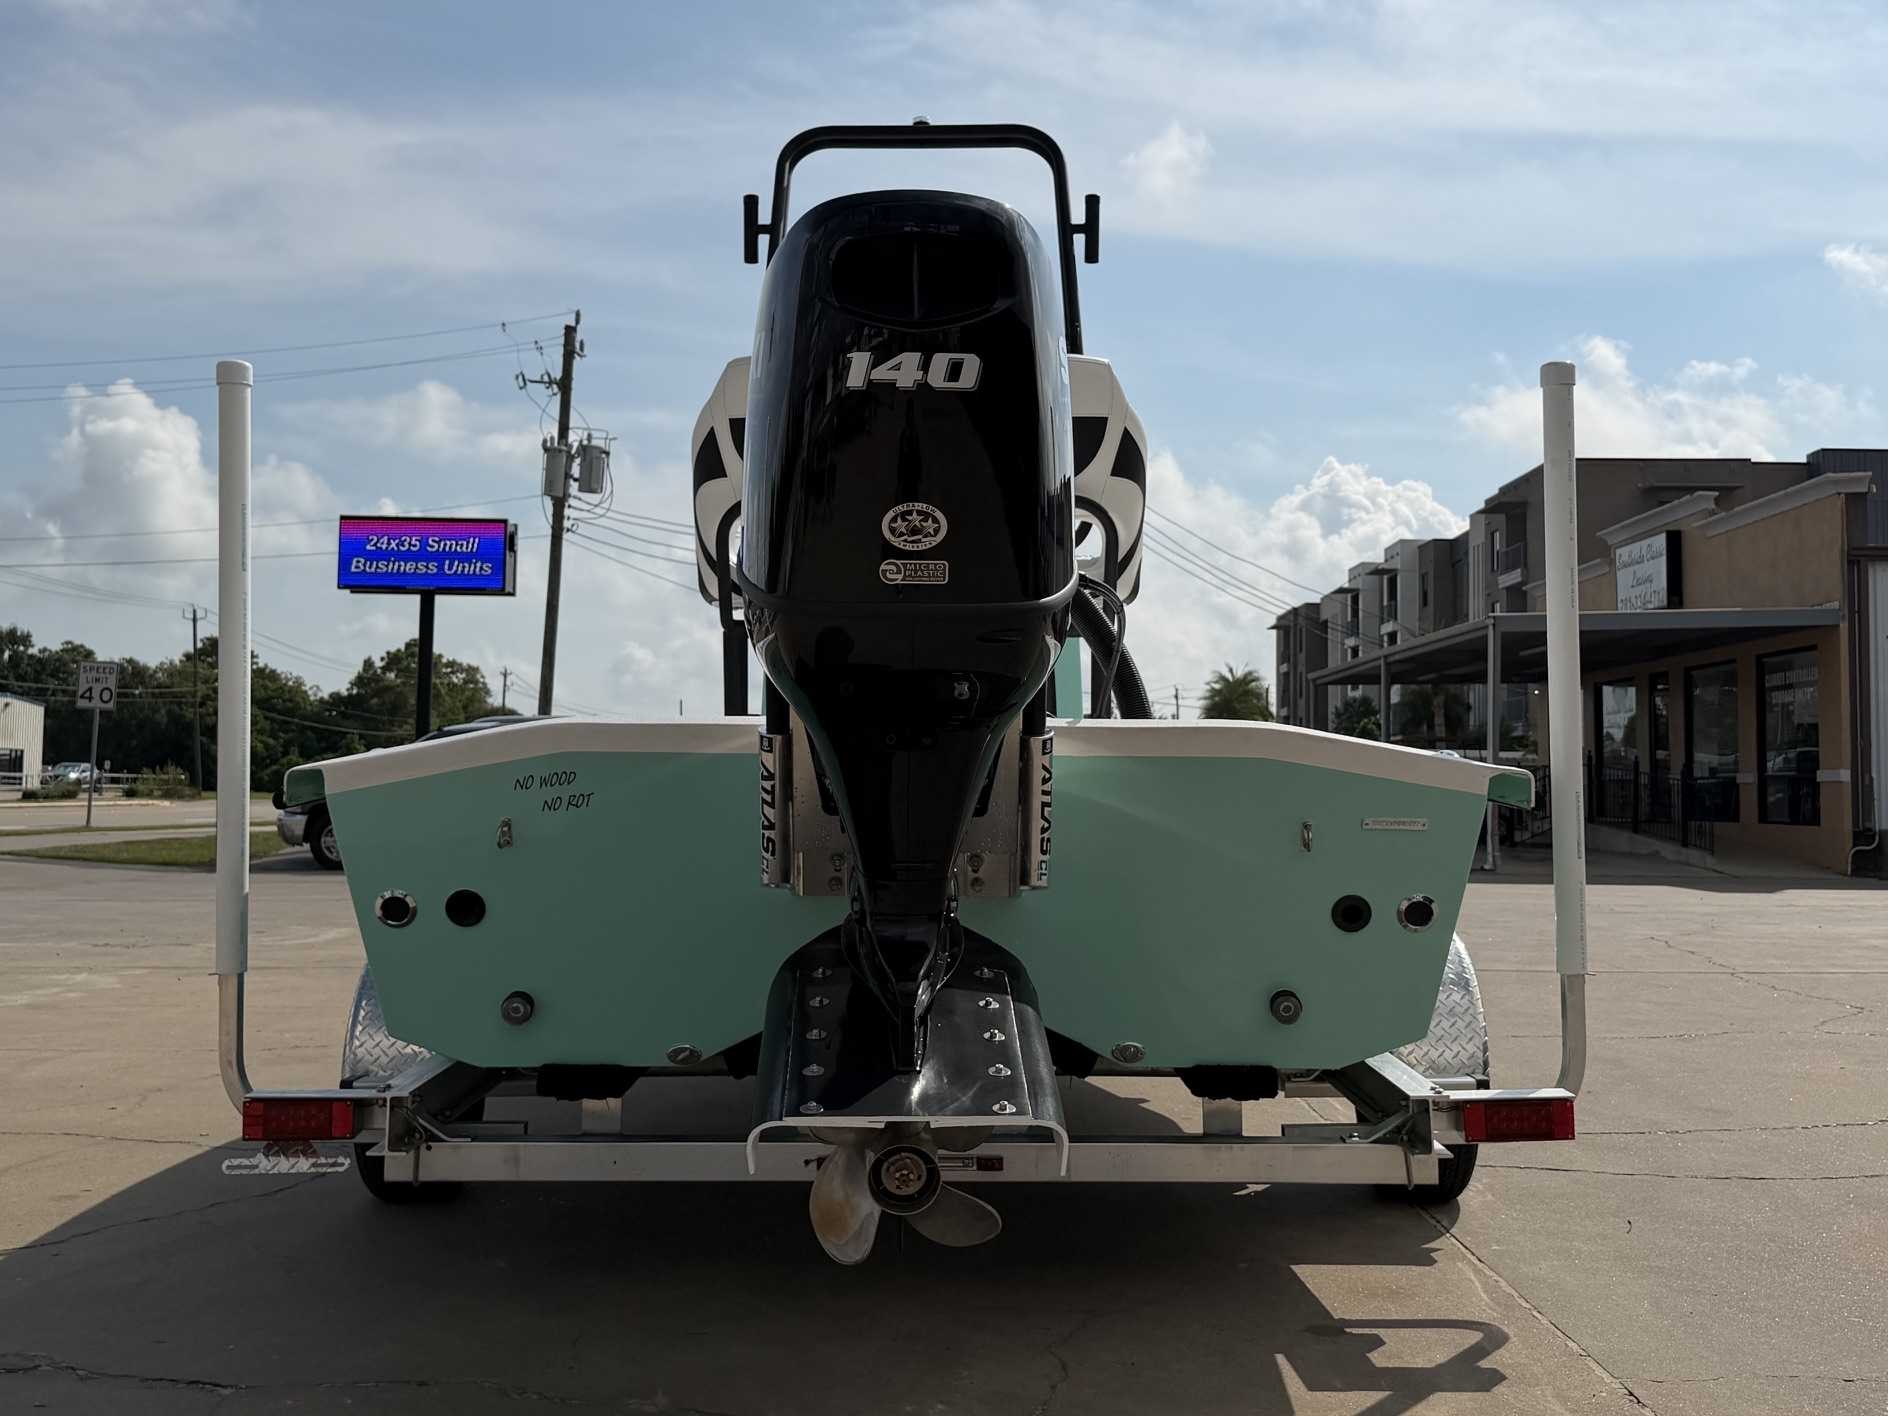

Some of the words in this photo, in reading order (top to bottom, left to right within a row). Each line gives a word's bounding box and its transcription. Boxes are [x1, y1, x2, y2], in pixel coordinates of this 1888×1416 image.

[846, 351, 984, 392] 140
[366, 535, 421, 551] 24x35
[426, 536, 479, 553] Small
[351, 557, 438, 574] Business
[443, 559, 493, 575] Units
[905, 563, 944, 571] MICRO
[82, 665, 114, 675] SPEED
[86, 676, 108, 684] LIMIT
[79, 686, 113, 704] 40
[514, 774, 535, 791] NO
[539, 770, 577, 789] WOOD
[542, 796, 563, 812] NO
[566, 792, 595, 812] ROT
[760, 759, 776, 858] ATLAS
[1040, 762, 1054, 857] ATLAS
